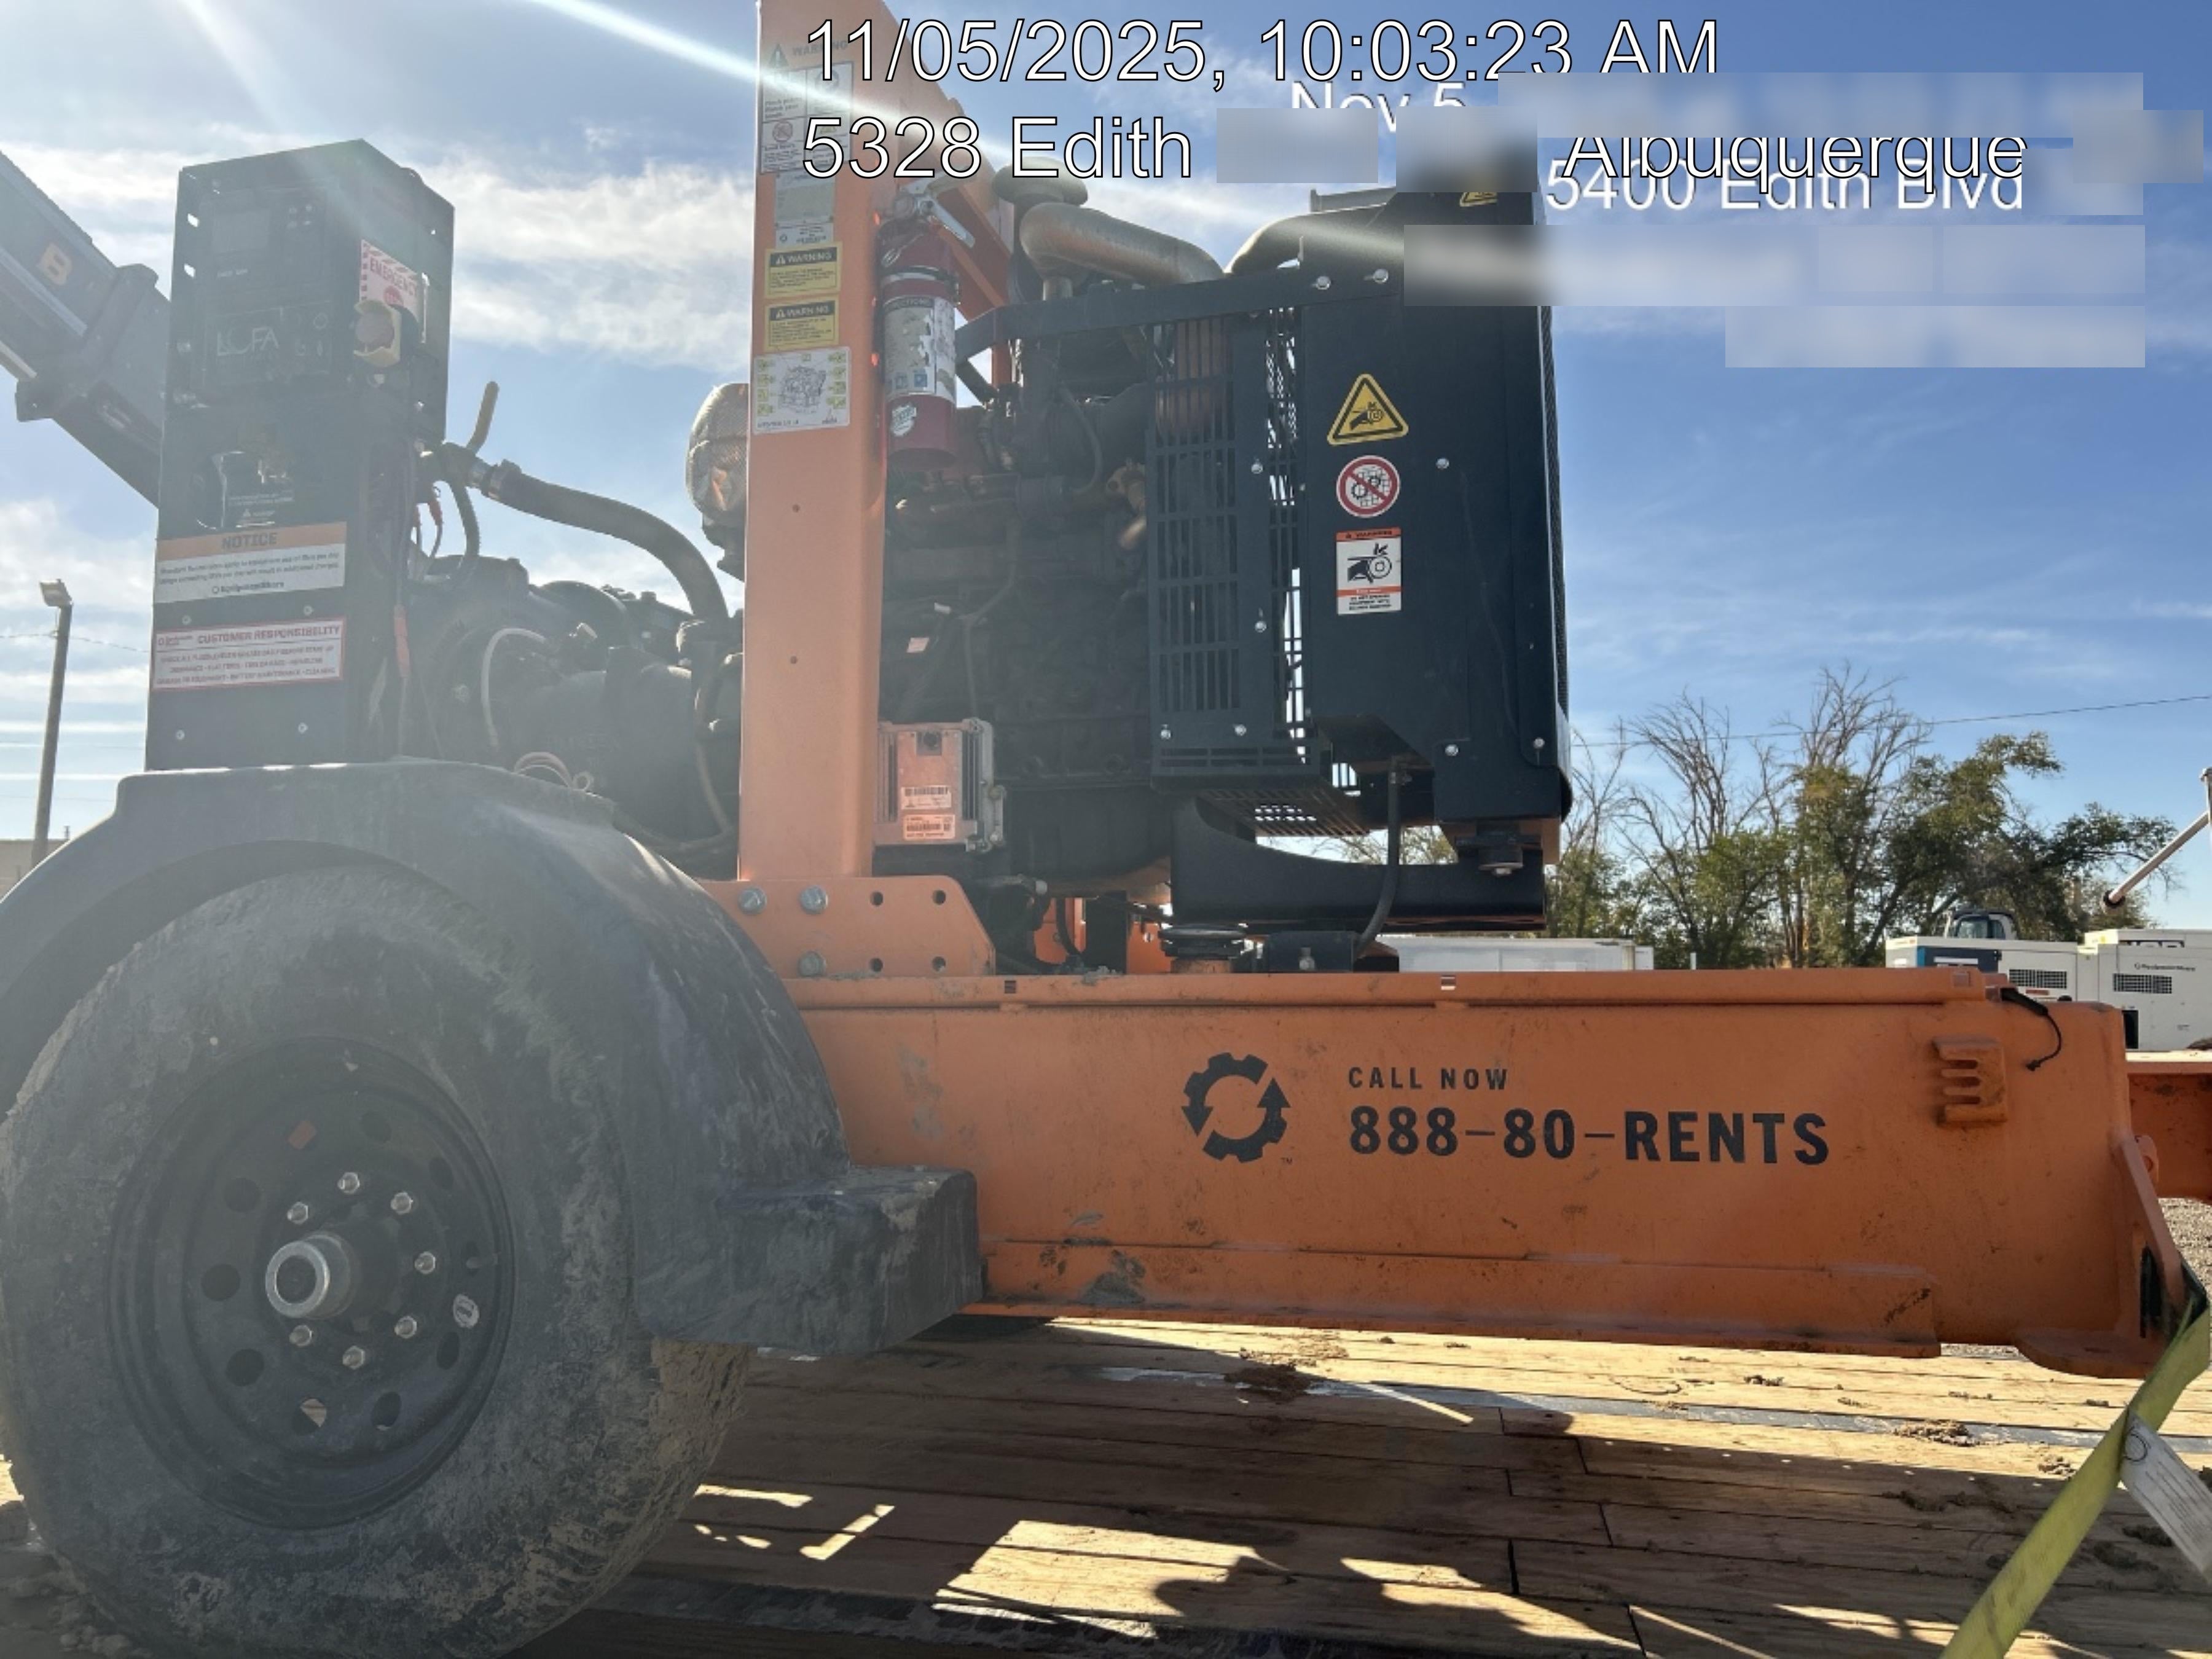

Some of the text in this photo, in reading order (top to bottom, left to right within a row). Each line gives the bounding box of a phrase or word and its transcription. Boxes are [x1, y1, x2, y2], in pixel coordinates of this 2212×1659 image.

[222, 532, 277, 549] NOTICE
[198, 632, 252, 644] CUSTOMER
[1348, 1067, 1508, 1091] CALL NOW
